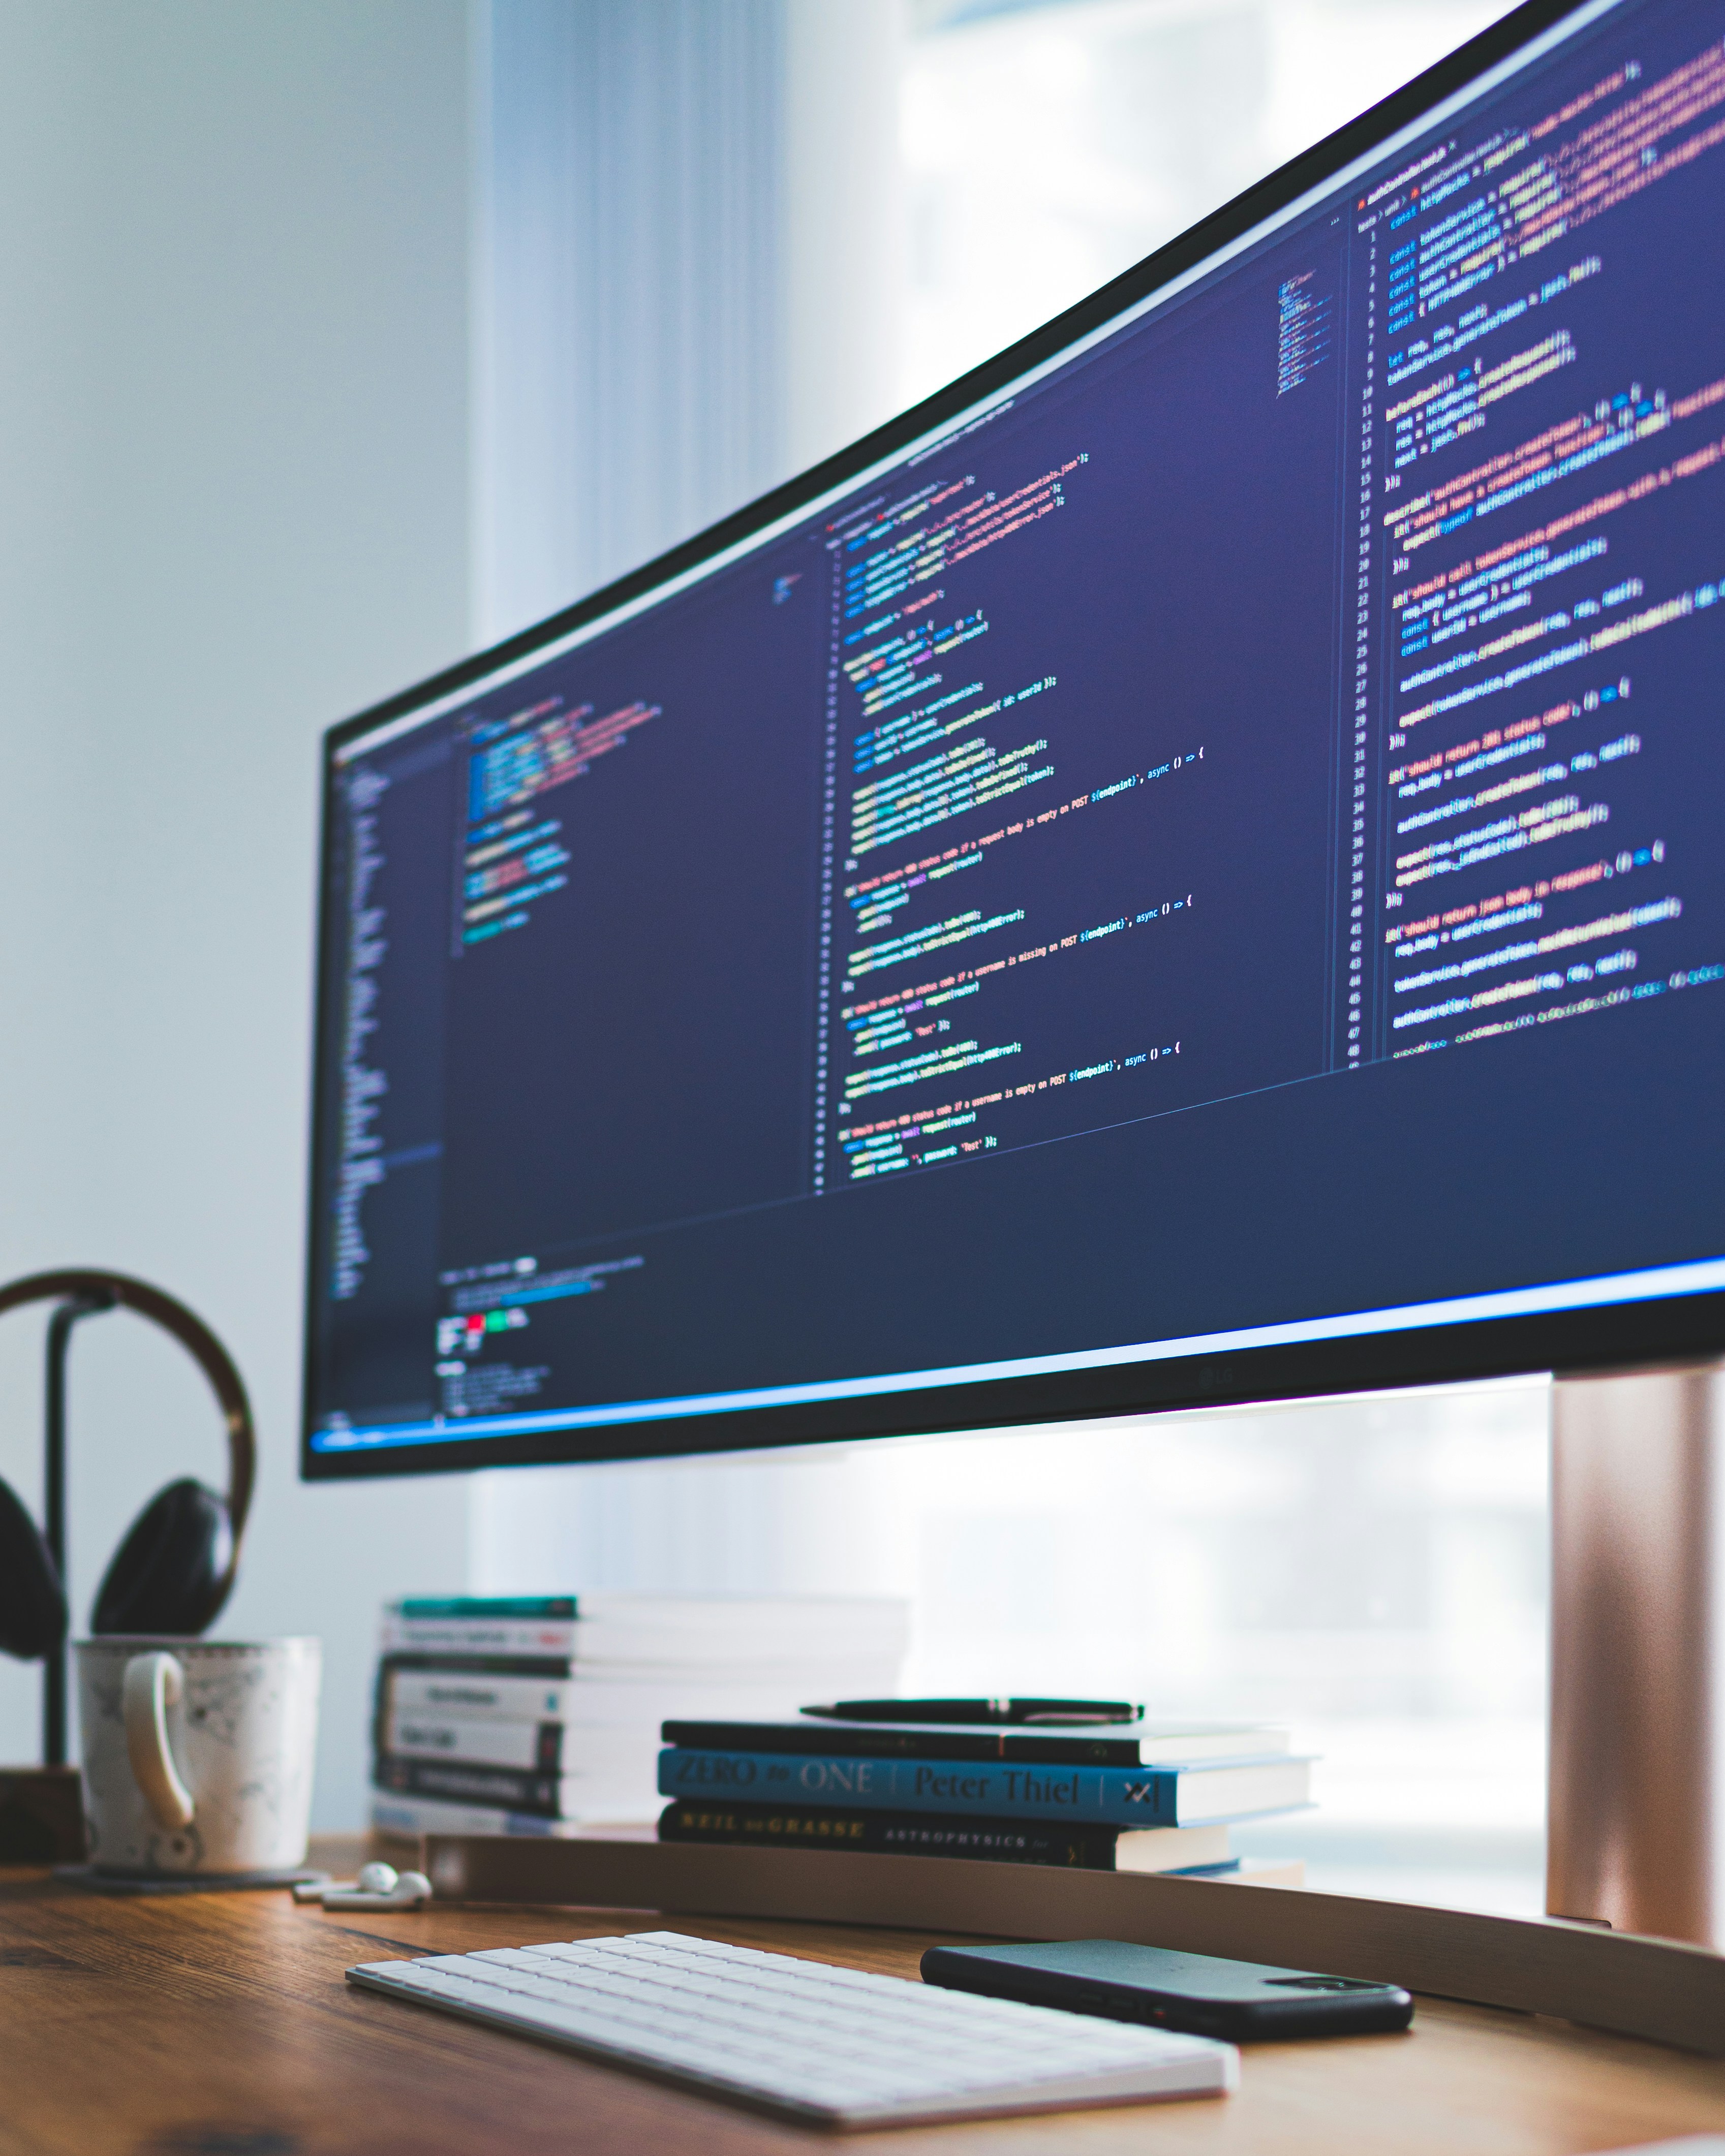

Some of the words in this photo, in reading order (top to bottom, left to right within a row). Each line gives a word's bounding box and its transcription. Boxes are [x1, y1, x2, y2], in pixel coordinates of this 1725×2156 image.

[1390, 205, 1417, 230] const
[1389, 240, 1416, 264] const
[1388, 258, 1415, 282] const
[1388, 275, 1415, 299] const
[1388, 293, 1415, 317] const
[1387, 310, 1414, 334] const
[1388, 351, 1404, 368] let
[1396, 416, 1413, 433] req
[1395, 433, 1412, 451] res
[1394, 448, 1417, 468] next
[1401, 617, 1429, 639] const
[1400, 635, 1429, 657] const
[960, 841, 969, 854] if
[970, 841, 976, 850] a
[978, 829, 1004, 846] request
[1006, 822, 1024, 835] body
[1026, 818, 1034, 828] is
[1036, 809, 1057, 823] empty
[1059, 804, 1069, 814] on
[1071, 794, 1089, 809] POST
[1091, 774, 1143, 802] ${endpoint}`,
[1147, 763, 1169, 779] async
[1173, 756, 1182, 769] ()
[1185, 753, 1195, 762] =>
[1198, 746, 1204, 759] {
[957, 971, 966, 982] if
[967, 971, 973, 979] a
[974, 960, 1005, 976] username
[1007, 956, 1016, 966] is
[1018, 946, 1046, 962] missing
[1049, 943, 1058, 952] on
[1060, 934, 1077, 948] POST
[1080, 917, 1132, 942] ${endpoint}`,
[1135, 909, 1158, 923] async
[1161, 902, 1170, 915] ()
[1173, 900, 1184, 909] =>
[1186, 894, 1192, 907] {
[911, 1109, 934, 1122] status
[953, 1100, 963, 1112] if
[964, 1100, 970, 1109] a
[971, 1092, 1002, 1107] username
[1004, 1088, 1013, 1099] is
[1015, 1083, 1036, 1095] empty
[1037, 1080, 1047, 1089] on
[1049, 1073, 1066, 1086] POST
[1069, 1059, 1120, 1081] ${endpoint}`,
[1124, 1053, 1146, 1067] async
[1150, 1048, 1158, 1060] ()
[1161, 1047, 1172, 1055] =>
[1174, 1041, 1180, 1054] {
[1215, 1367, 1233, 1385] LG
[676, 1755, 757, 1786] ZERO
[799, 1760, 874, 1793] ONE
[915, 1766, 990, 1799] Peter
[1002, 1770, 1080, 1804] Thiel
[681, 1812, 736, 1830] NEIL
[885, 1829, 1027, 1849] ASTROPHYSICS
